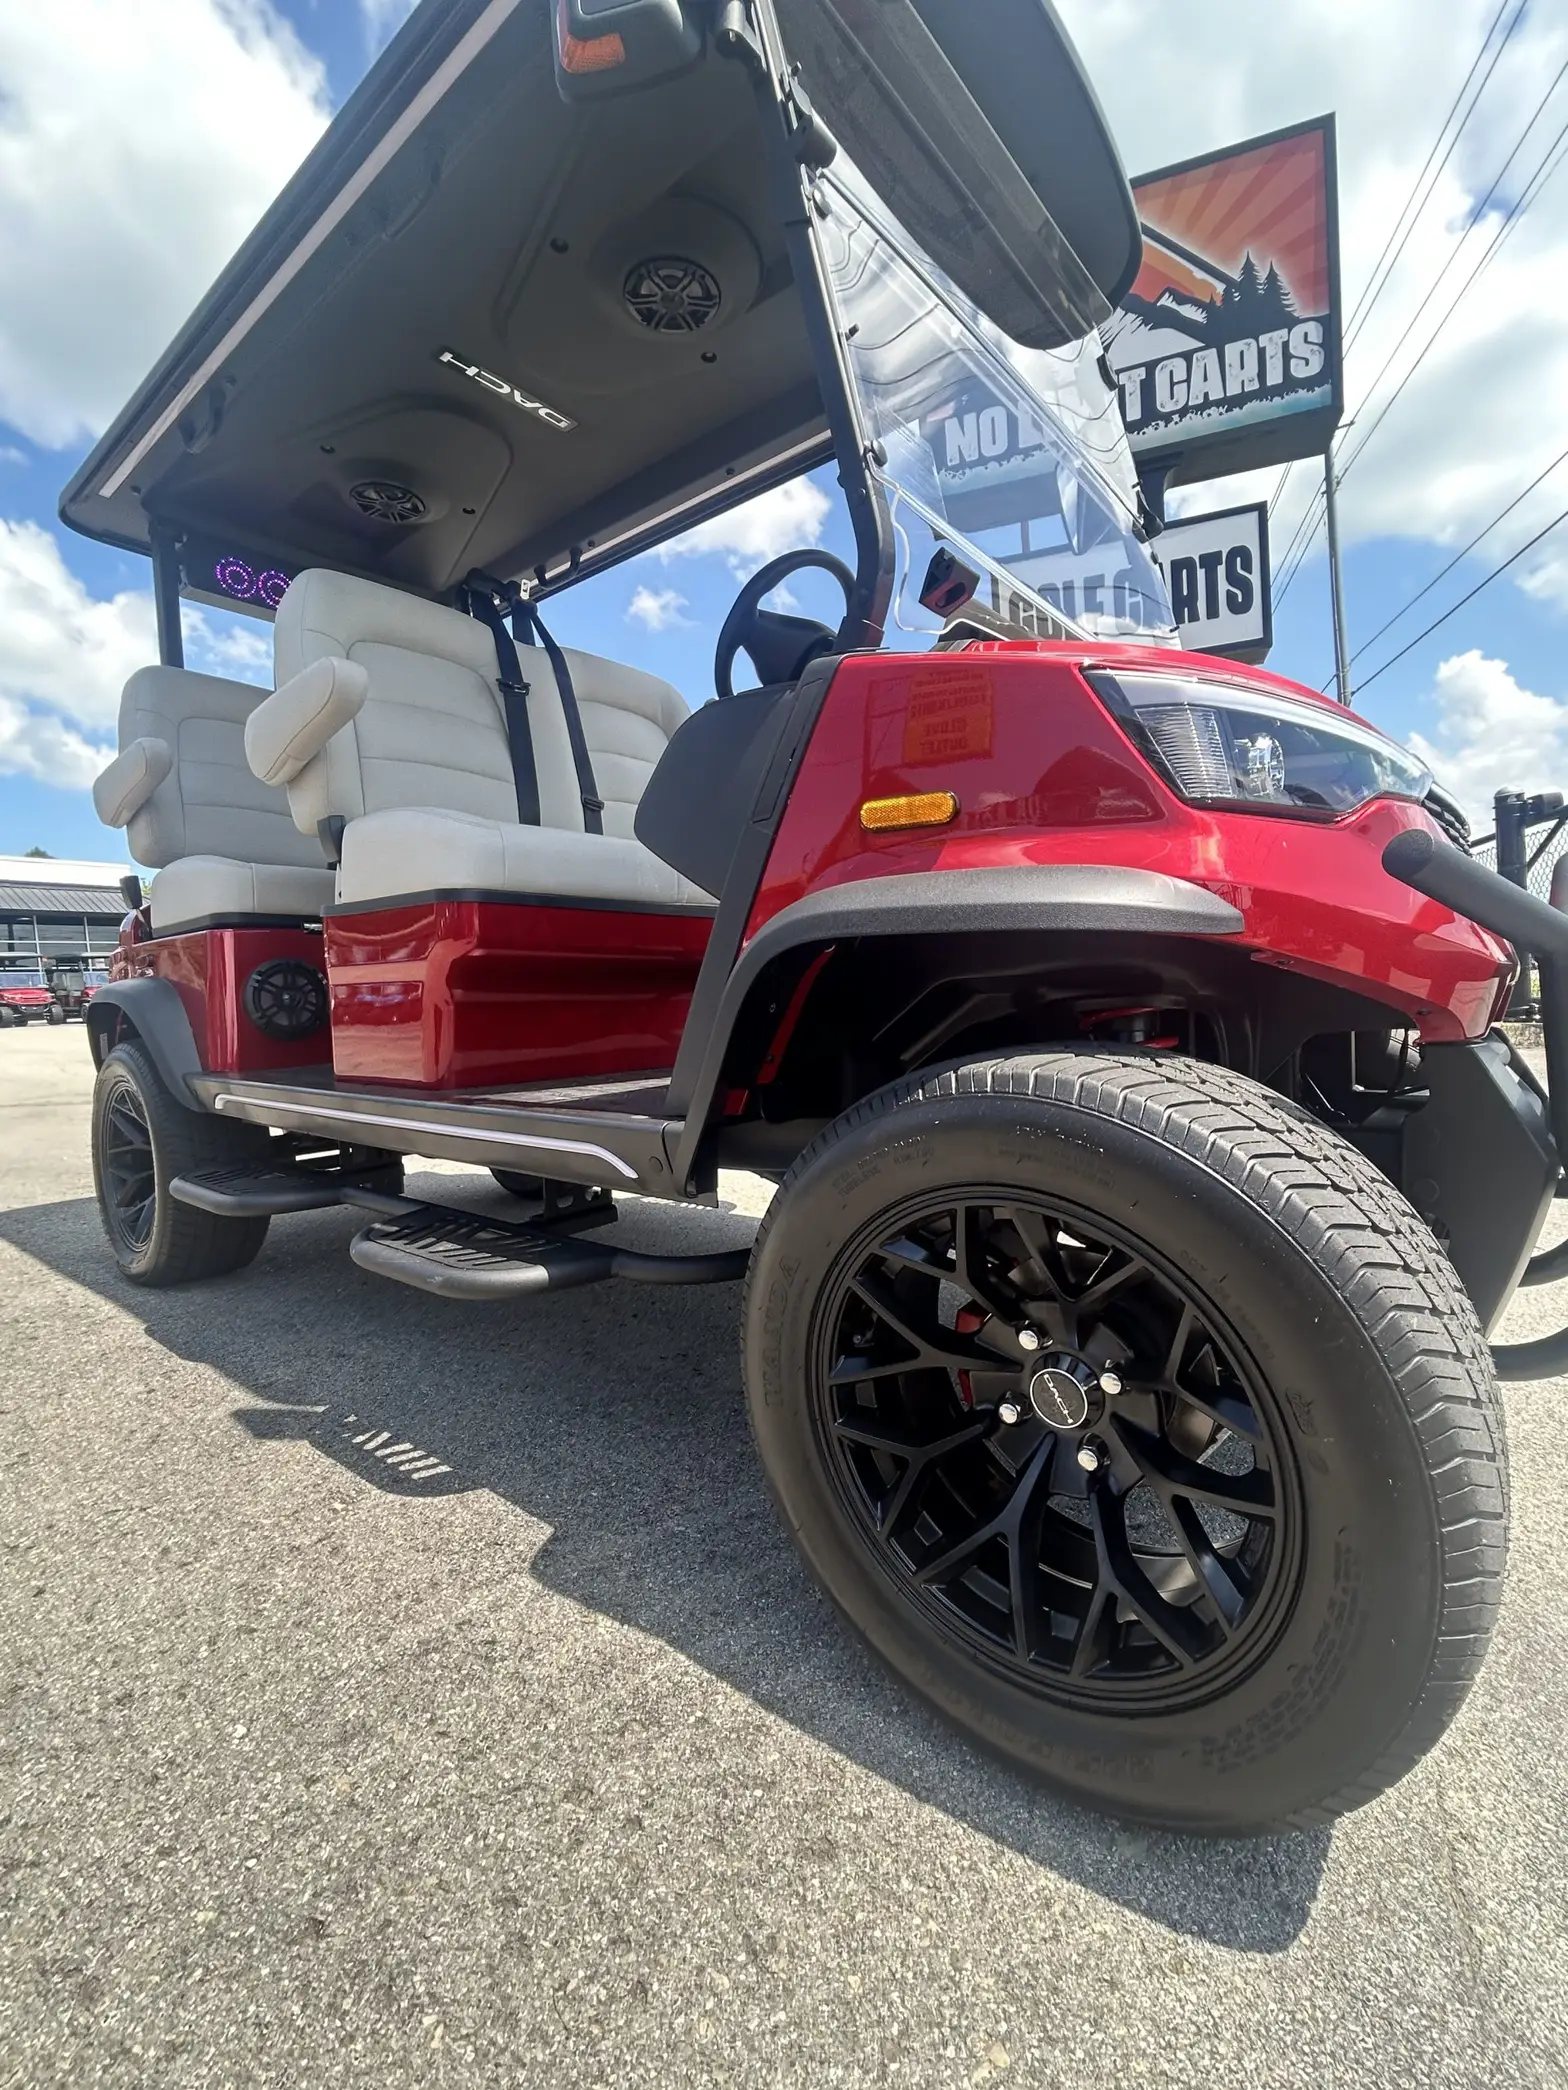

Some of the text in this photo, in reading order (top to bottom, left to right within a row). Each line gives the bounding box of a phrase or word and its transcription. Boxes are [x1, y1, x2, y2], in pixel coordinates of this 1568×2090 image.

[439, 351, 572, 428] DACH
[945, 405, 1008, 466] NO
[1155, 321, 1325, 413] CARTS
